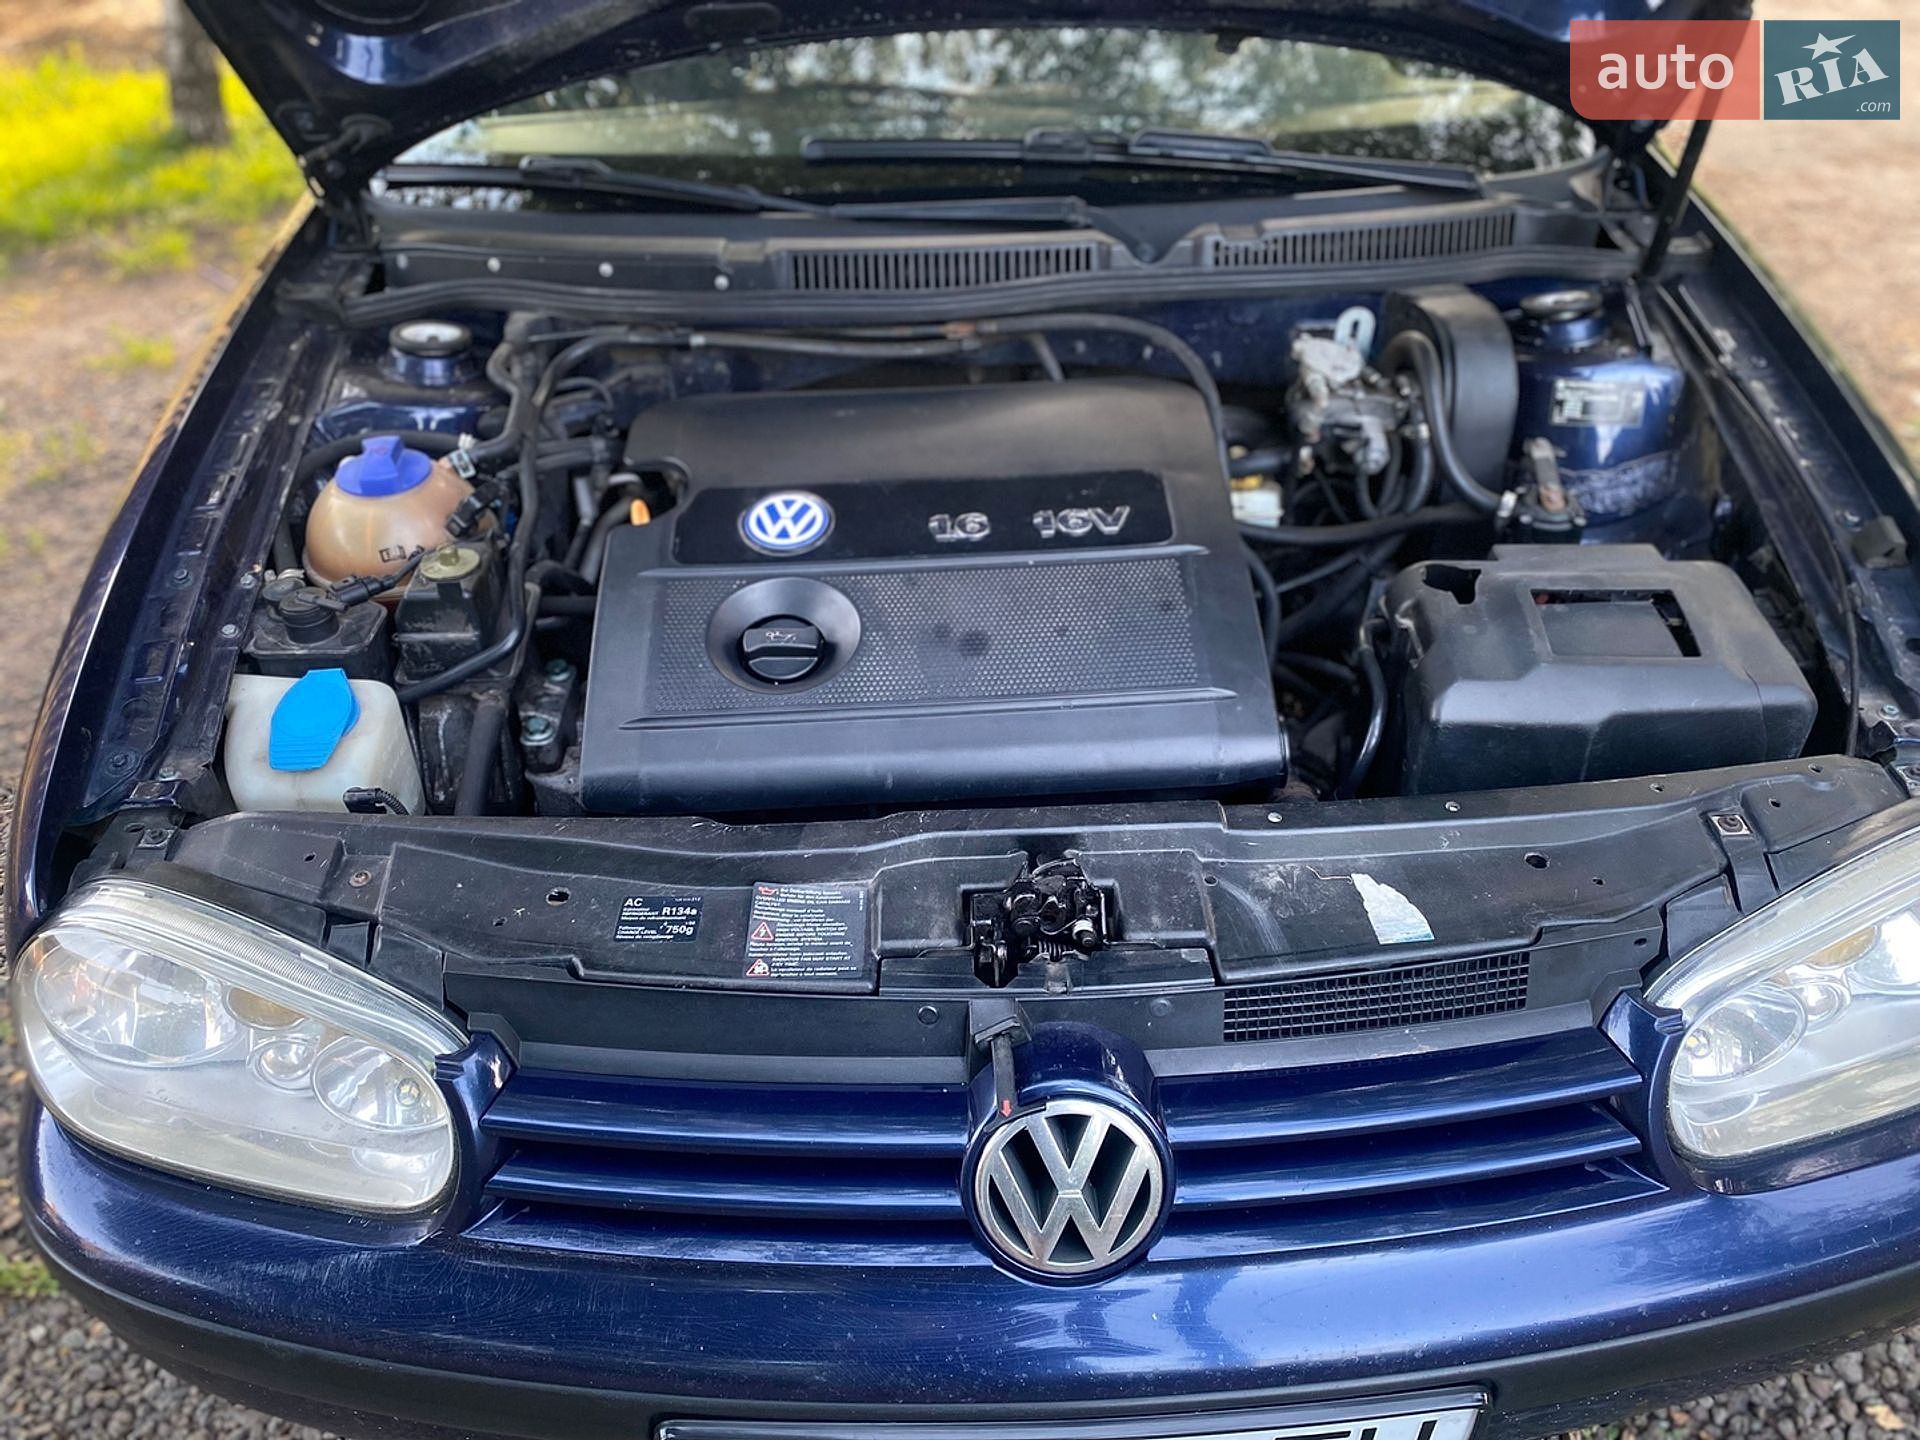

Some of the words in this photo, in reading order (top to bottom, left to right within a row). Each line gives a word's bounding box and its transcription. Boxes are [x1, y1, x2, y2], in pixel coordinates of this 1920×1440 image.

[745, 492, 831, 548] VW
[1032, 505, 1130, 538] 16V
[624, 898, 643, 907] AC
[662, 906, 698, 916] R134a
[666, 925, 694, 936] 750g
[977, 1102, 1162, 1272] VW
